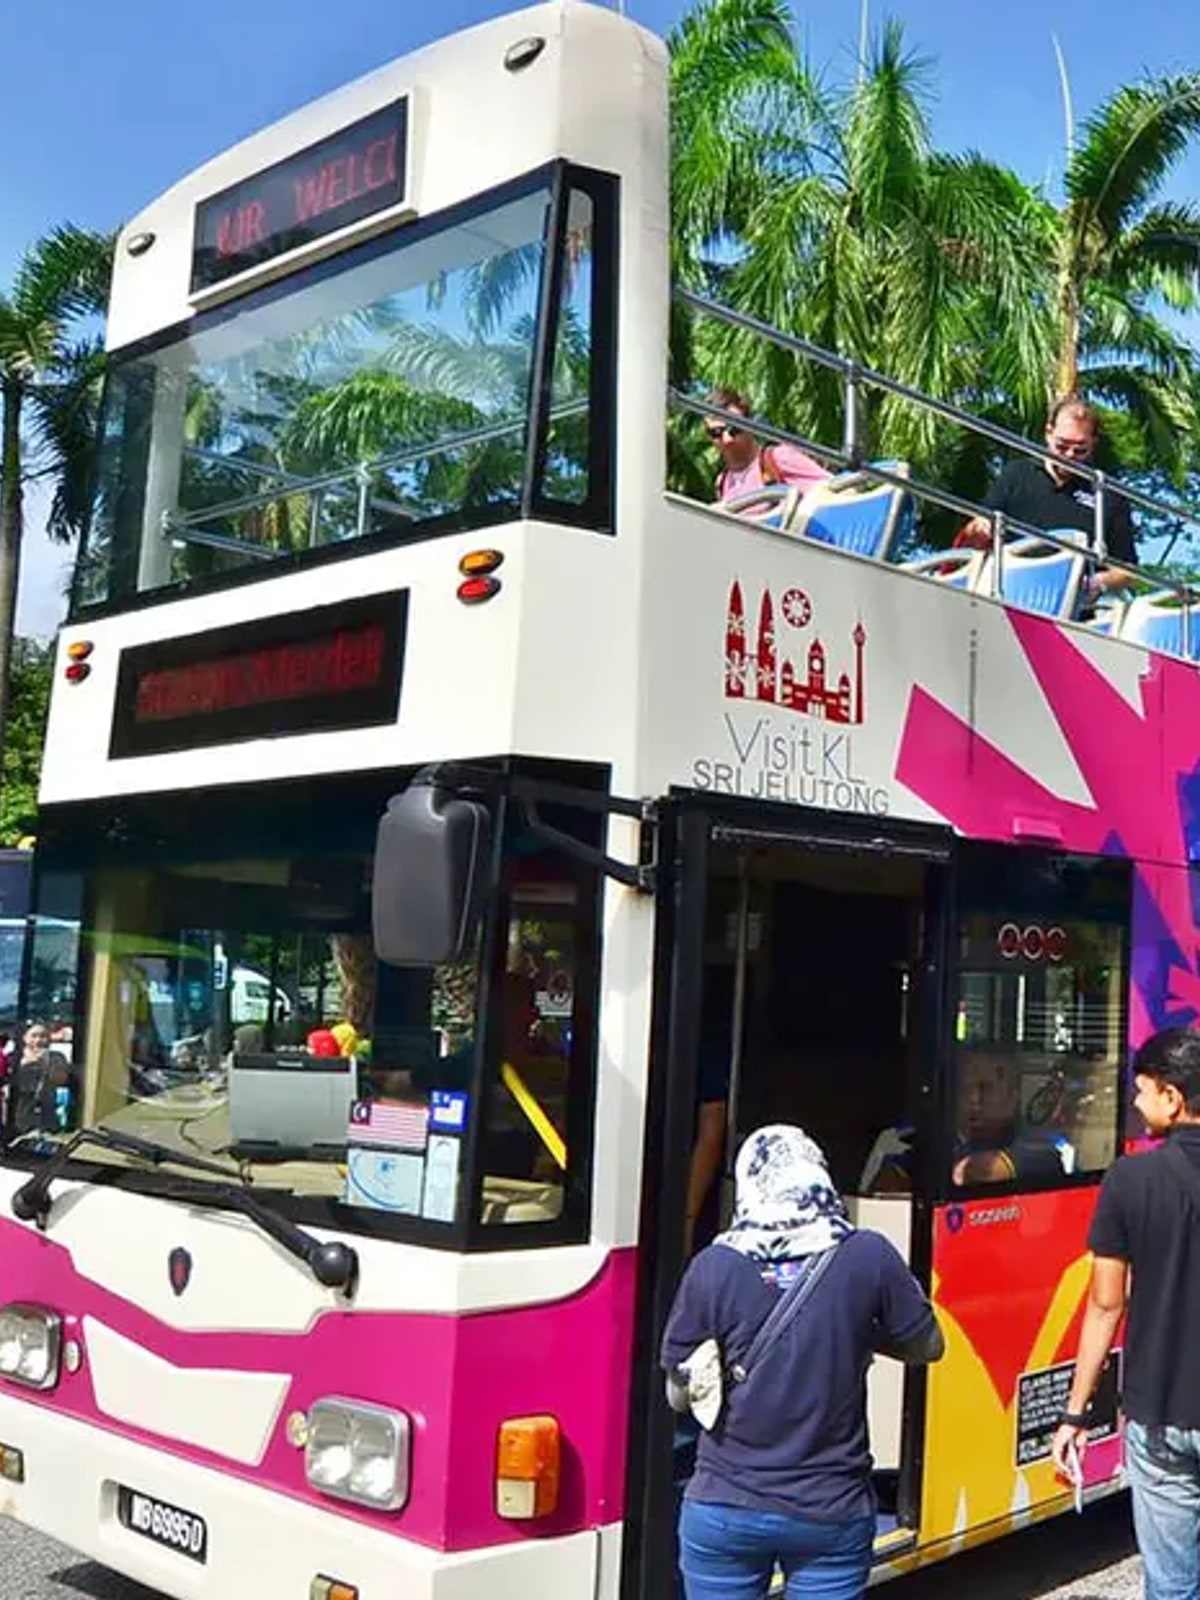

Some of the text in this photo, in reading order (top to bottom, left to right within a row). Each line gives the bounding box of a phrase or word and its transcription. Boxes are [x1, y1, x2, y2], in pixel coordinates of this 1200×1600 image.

[724, 712, 866, 785] Visit KL
[693, 759, 889, 815] SRI JELUTONG
